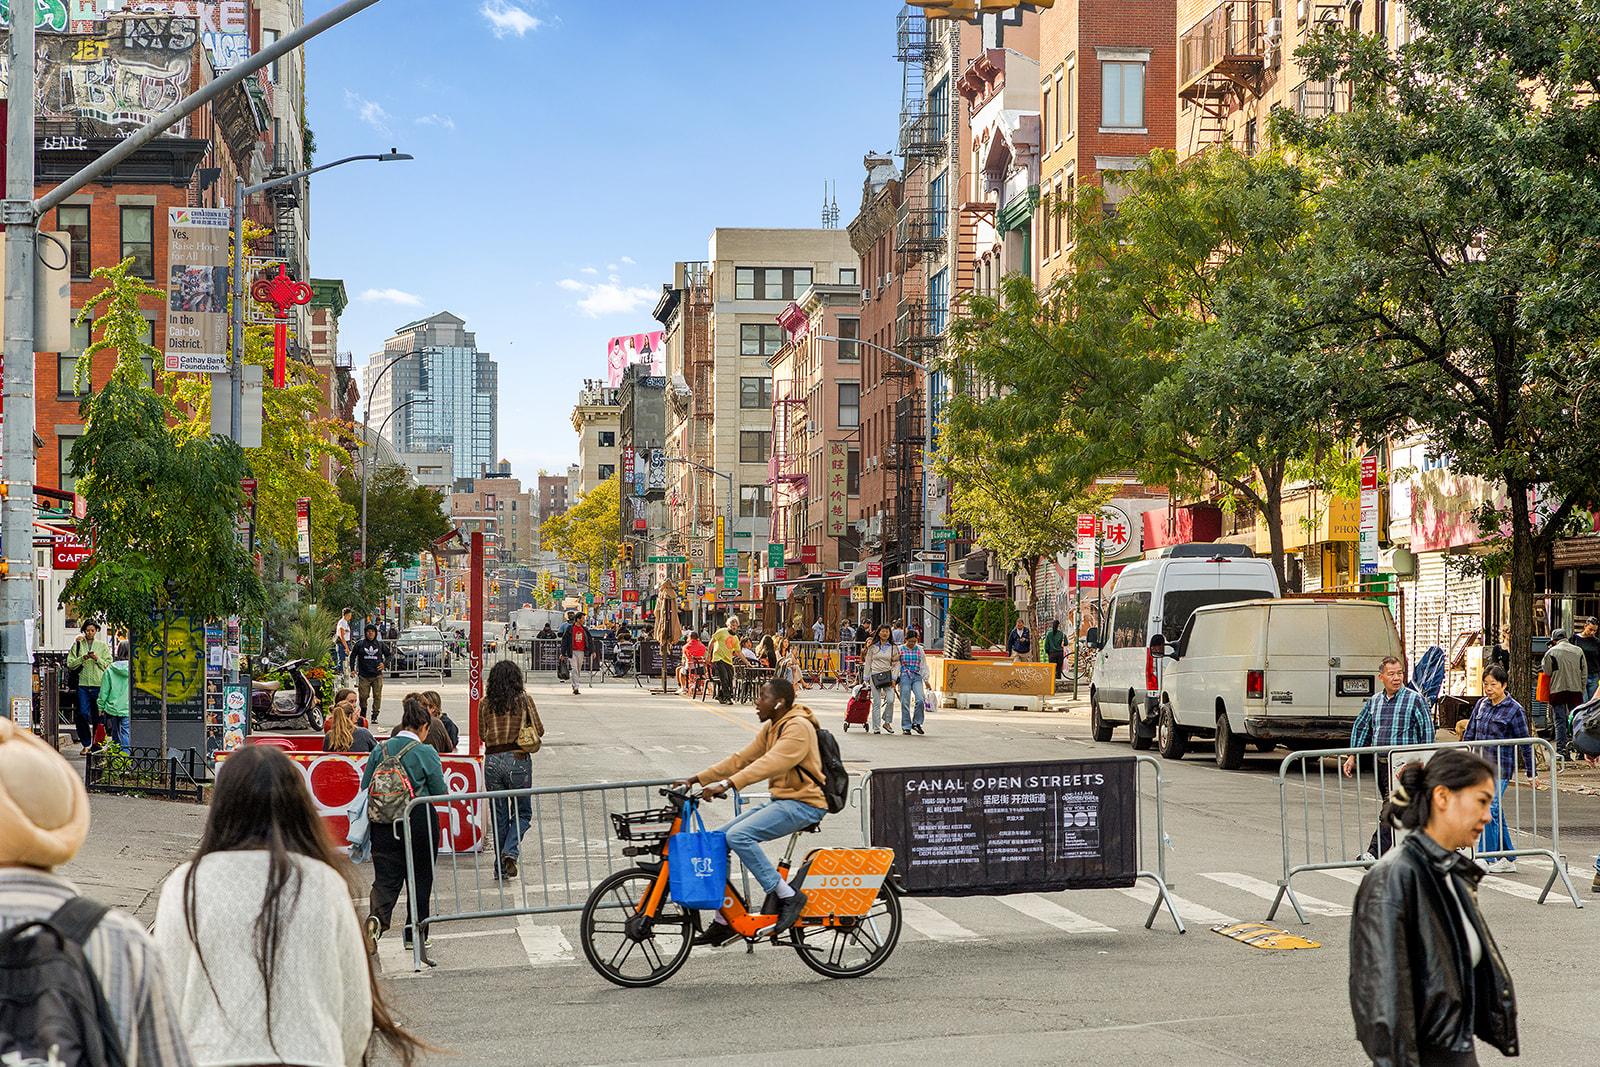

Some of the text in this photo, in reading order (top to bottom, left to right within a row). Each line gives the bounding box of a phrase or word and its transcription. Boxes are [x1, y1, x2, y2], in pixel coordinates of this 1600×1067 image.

[172, 229, 189, 240] Yes,
[172, 241, 220, 254] Raise Hope
[172, 251, 198, 260] for All
[169, 314, 194, 324] In the
[169, 326, 200, 337] Can-Do
[169, 338, 203, 349] District.
[180, 356, 225, 365] Cathay Bank
[1342, 503, 1357, 511] TV
[906, 774, 1104, 791] CANAL OPEN STREETS
[1010, 793, 1046, 804] 开放街道
[1064, 812, 1097, 827] DOT
[820, 876, 862, 888] JOCO
